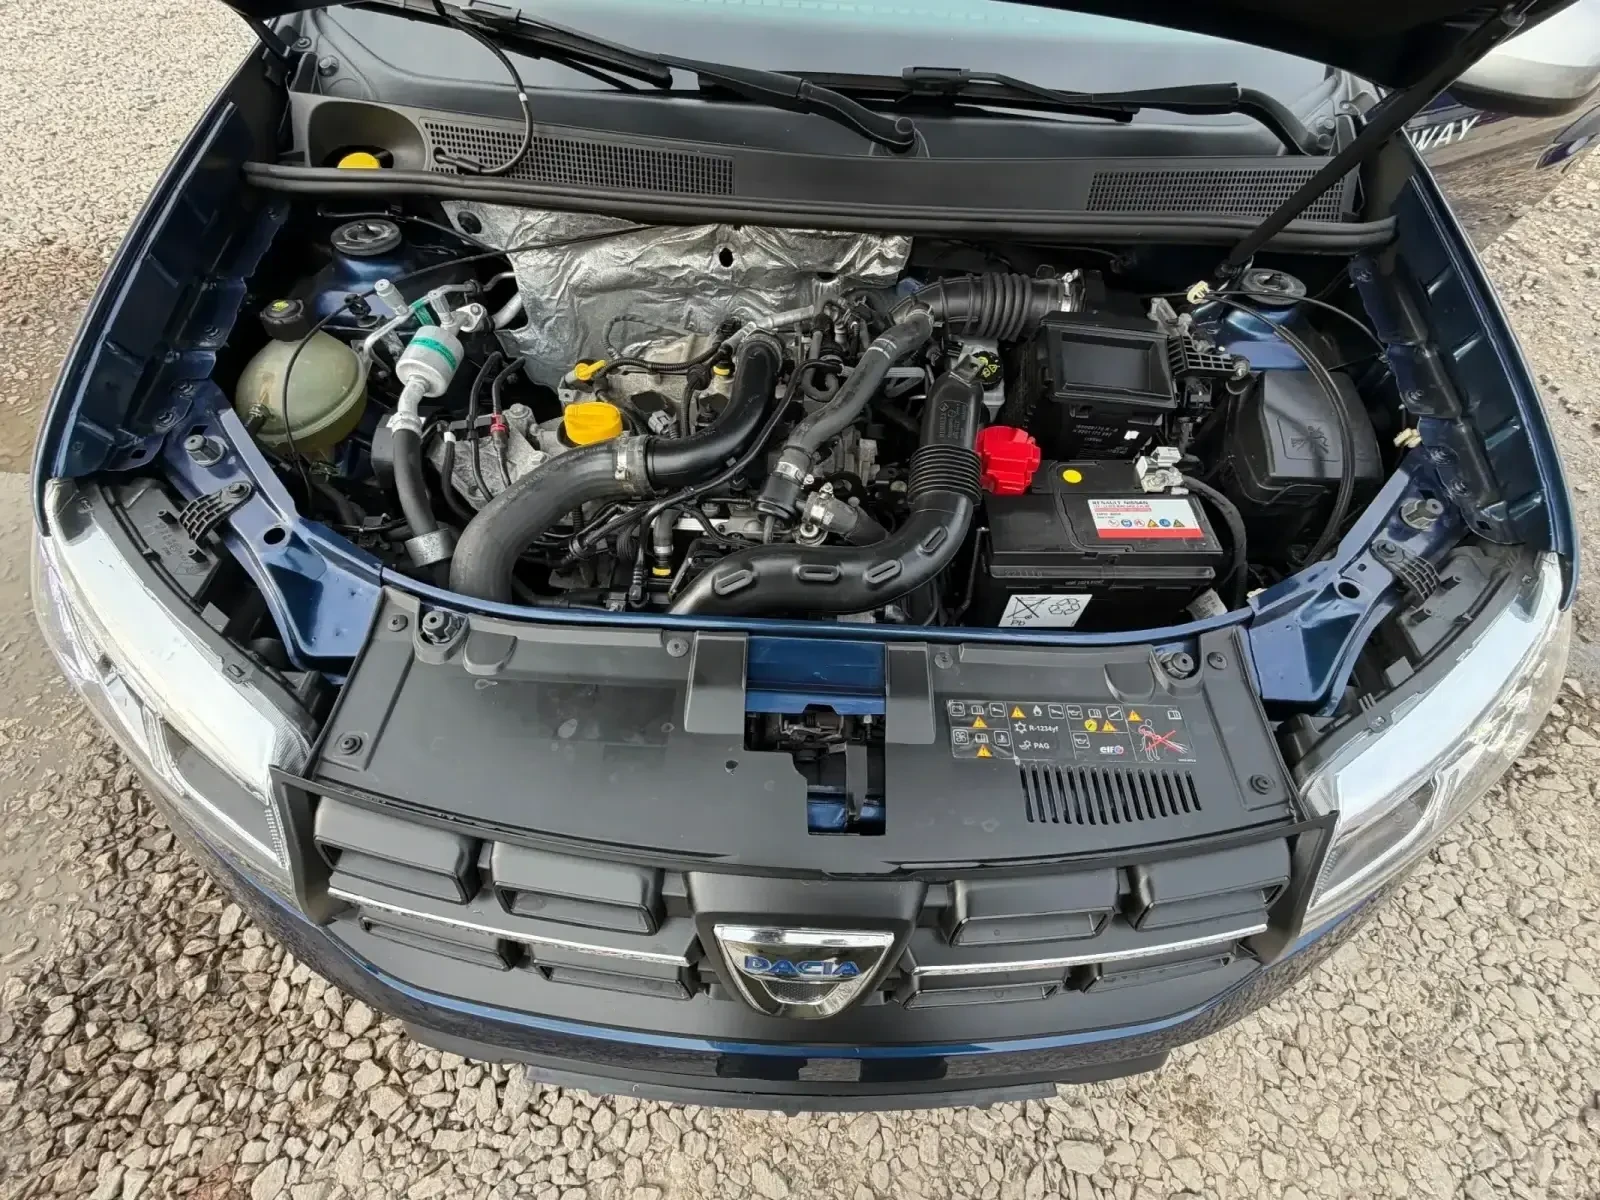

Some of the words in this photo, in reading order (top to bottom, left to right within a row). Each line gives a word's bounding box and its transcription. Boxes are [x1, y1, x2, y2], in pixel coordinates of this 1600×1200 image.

[1411, 115, 1480, 151] WAY
[1028, 724, 1059, 733] R-1234yf
[1033, 742, 1050, 750] PAG
[744, 955, 861, 977] DACIA
